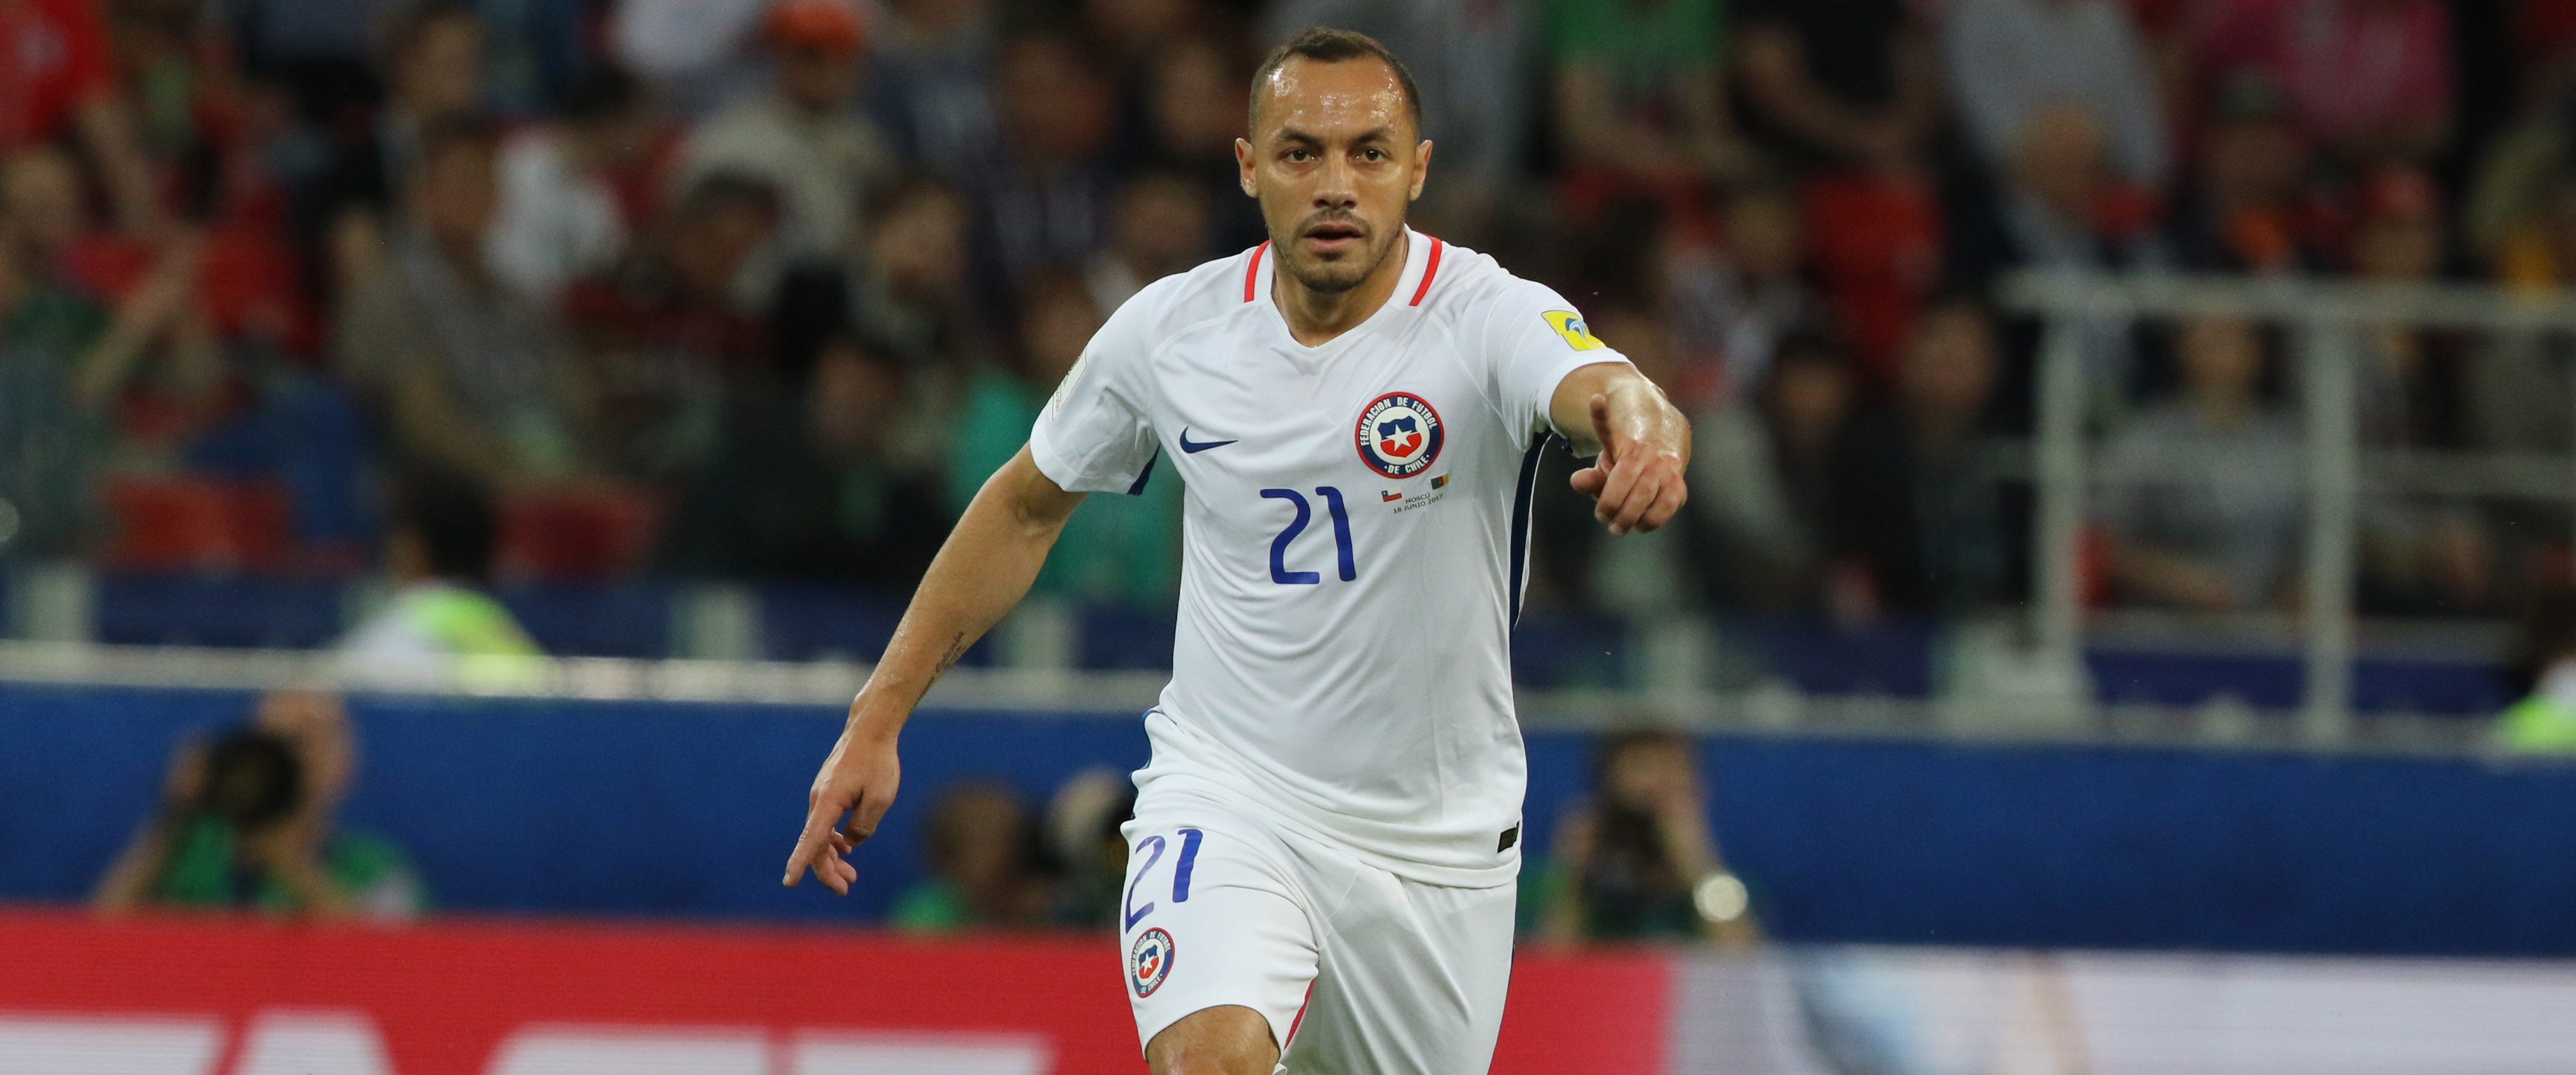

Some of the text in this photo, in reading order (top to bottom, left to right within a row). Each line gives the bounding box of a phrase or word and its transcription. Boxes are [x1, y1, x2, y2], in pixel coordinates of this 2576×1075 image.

[1360, 396, 1438, 446] FEDERACION DE FUTBOL
[1387, 457, 1429, 474] DE CHILE
[1404, 501, 1426, 511] JUNIO
[1428, 494, 1443, 504] 2017
[1406, 491, 1430, 504] MOSCÚ
[1260, 486, 1356, 584] 21
[1125, 829, 1203, 935] 21
[1157, 931, 1172, 952] FUTBOL
[1148, 976, 1162, 991] CHILE
